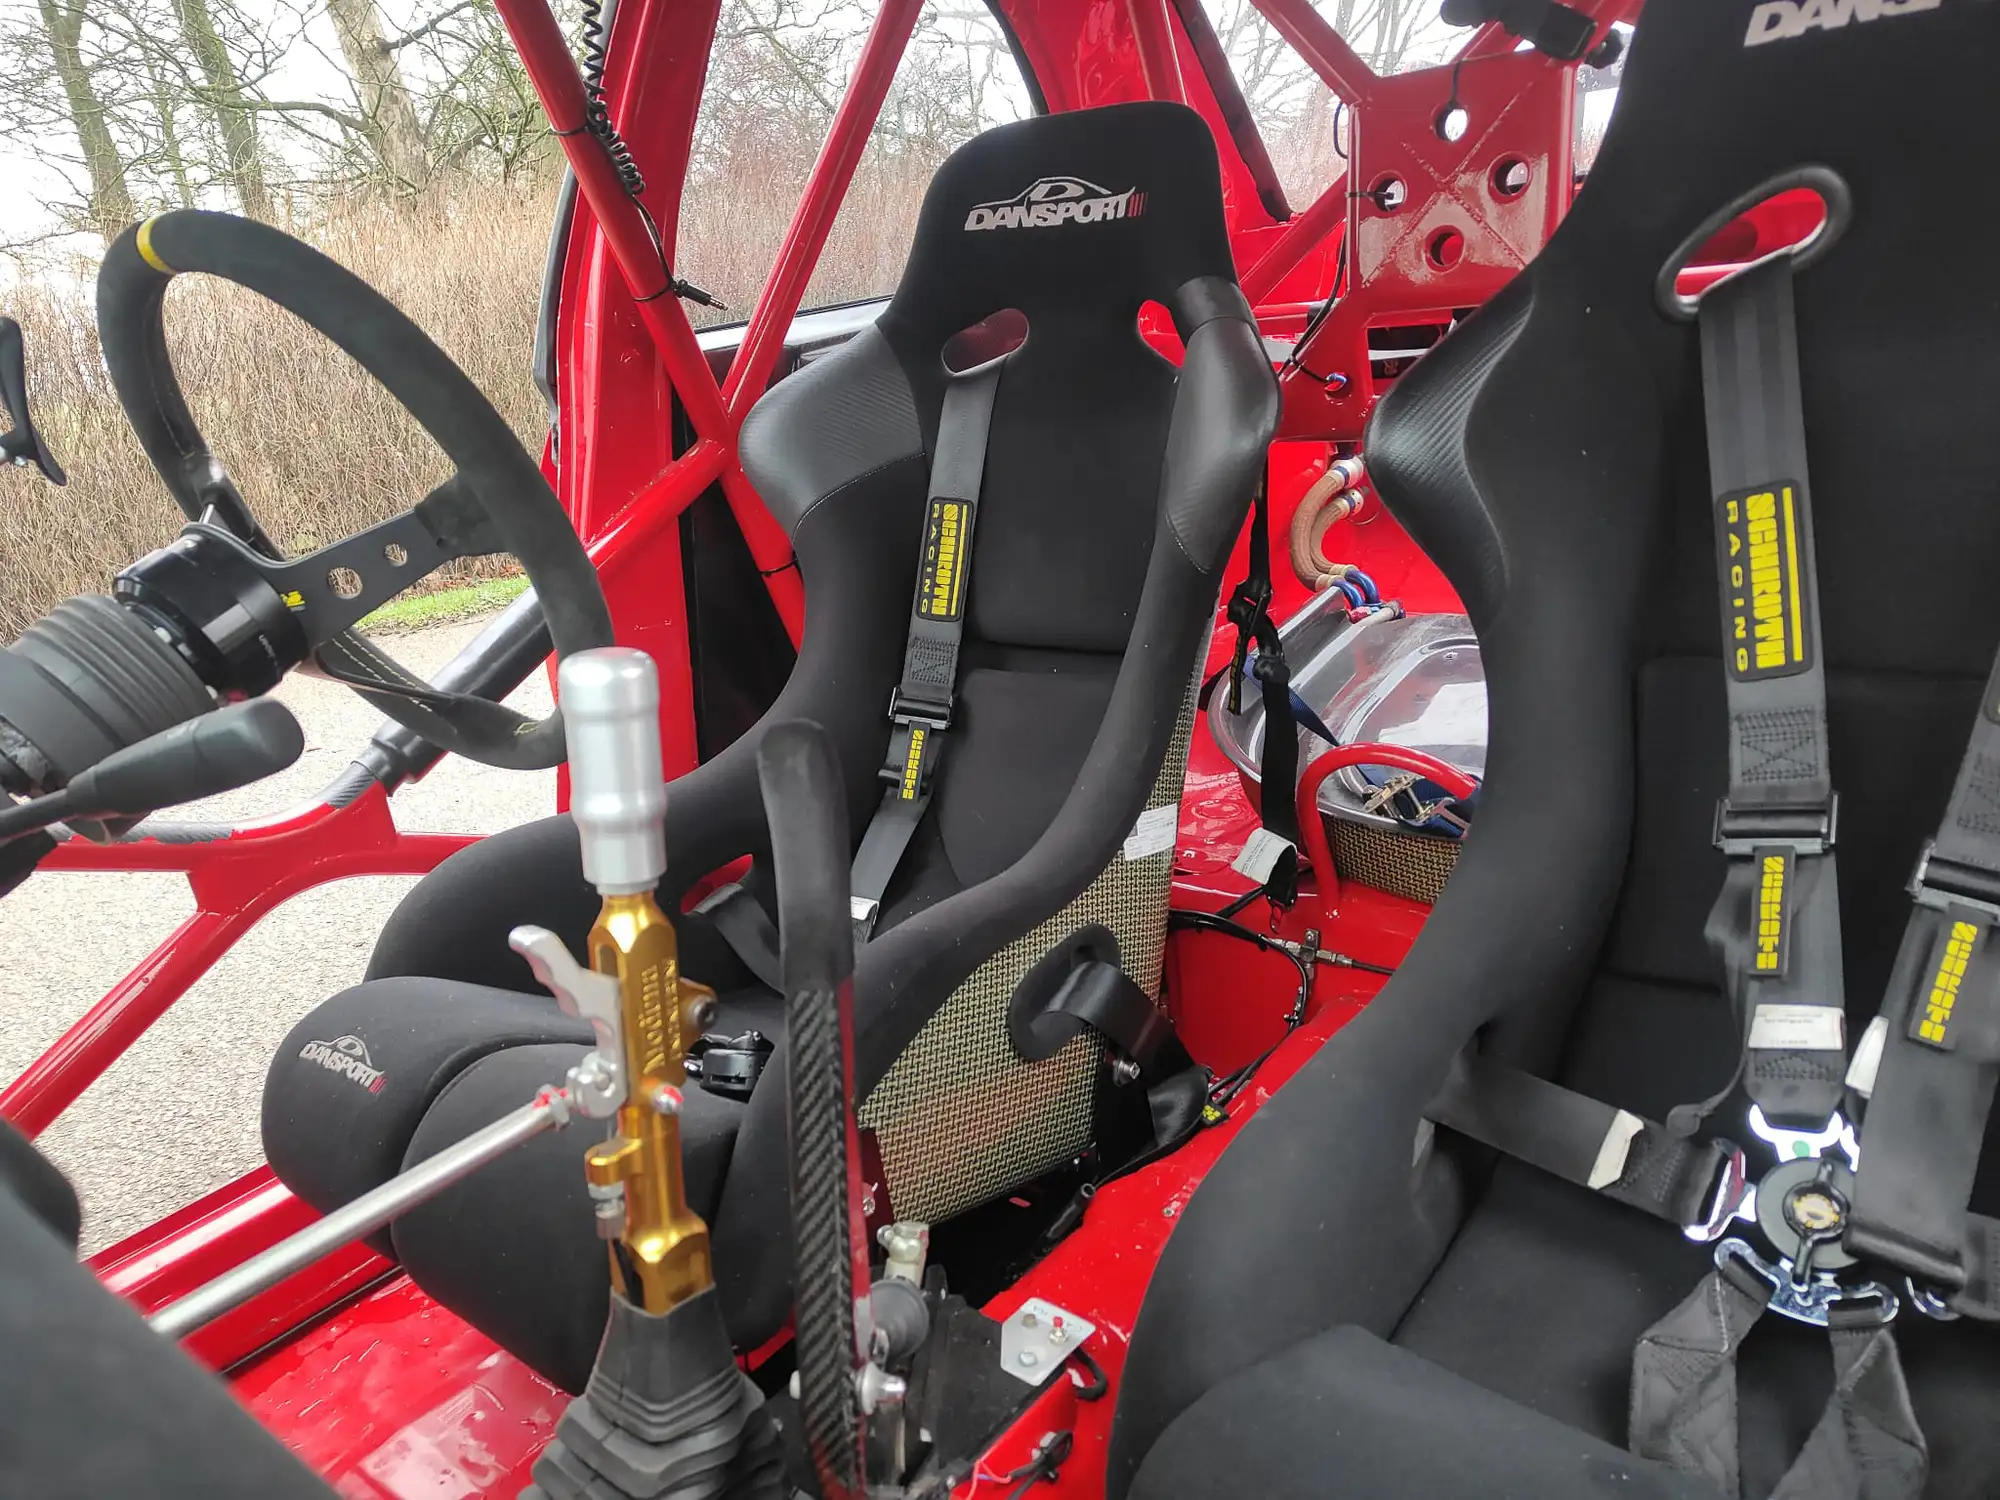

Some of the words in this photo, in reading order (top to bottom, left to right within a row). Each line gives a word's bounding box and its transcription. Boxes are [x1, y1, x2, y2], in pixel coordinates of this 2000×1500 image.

[964, 188, 1135, 231] DANSPORT
[921, 503, 940, 614] RACING
[930, 503, 959, 616] SCHROTH
[1726, 500, 1748, 672] RACING
[1746, 492, 1785, 669] SCHROTH
[1756, 856, 1784, 970] SCHROTH
[1919, 921, 1978, 1043] SCHROTH
[299, 1043, 383, 1088] DANSPORT
